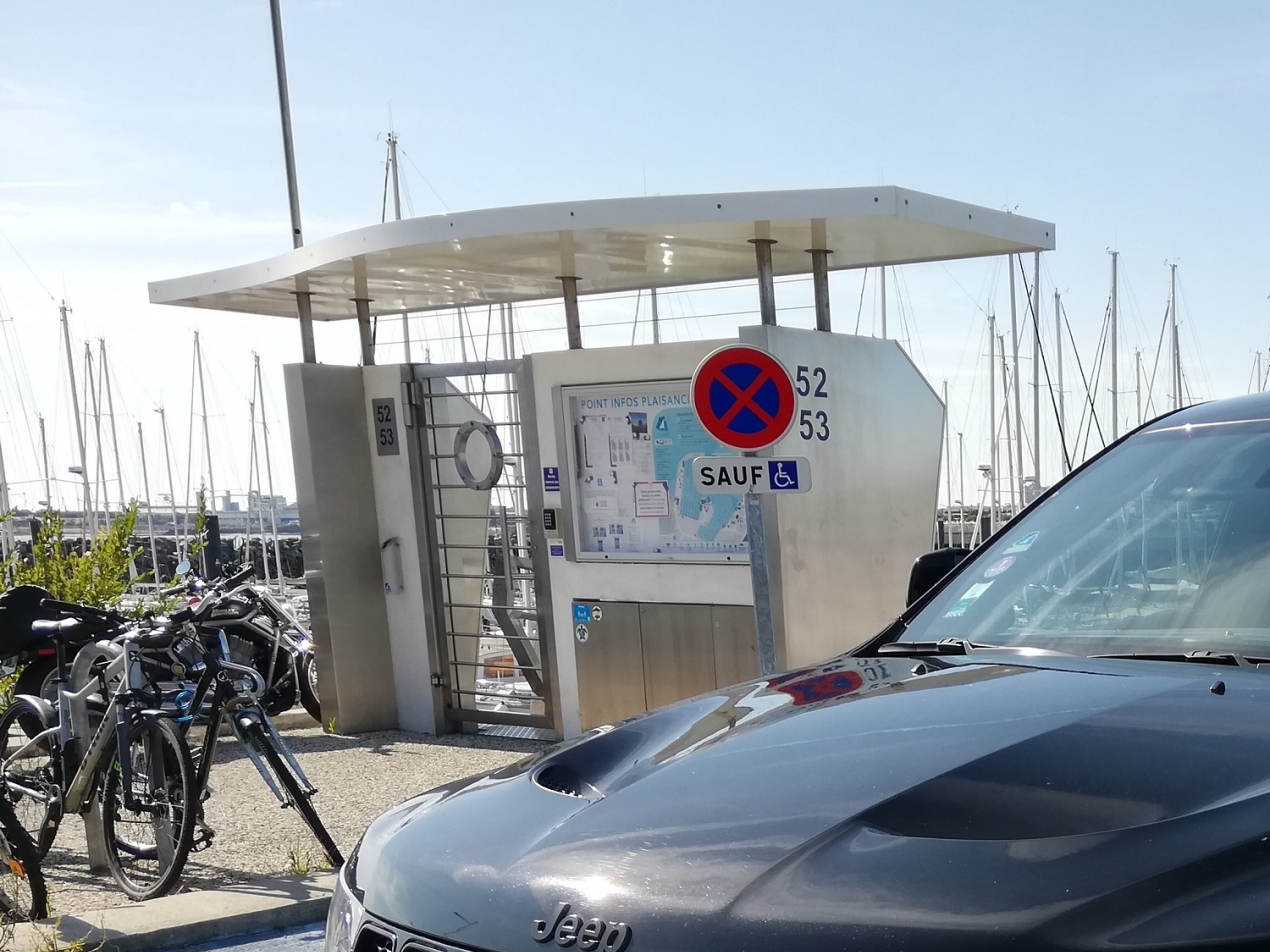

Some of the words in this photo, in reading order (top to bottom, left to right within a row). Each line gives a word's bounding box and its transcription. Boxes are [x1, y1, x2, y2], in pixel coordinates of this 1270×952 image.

[796, 365, 828, 398] 52
[581, 398, 608, 410] POINT
[611, 396, 639, 408] INFOS
[377, 405, 392, 423] 52
[799, 409, 830, 441] 53
[380, 428, 394, 446] 53
[700, 465, 763, 486] SAUF
